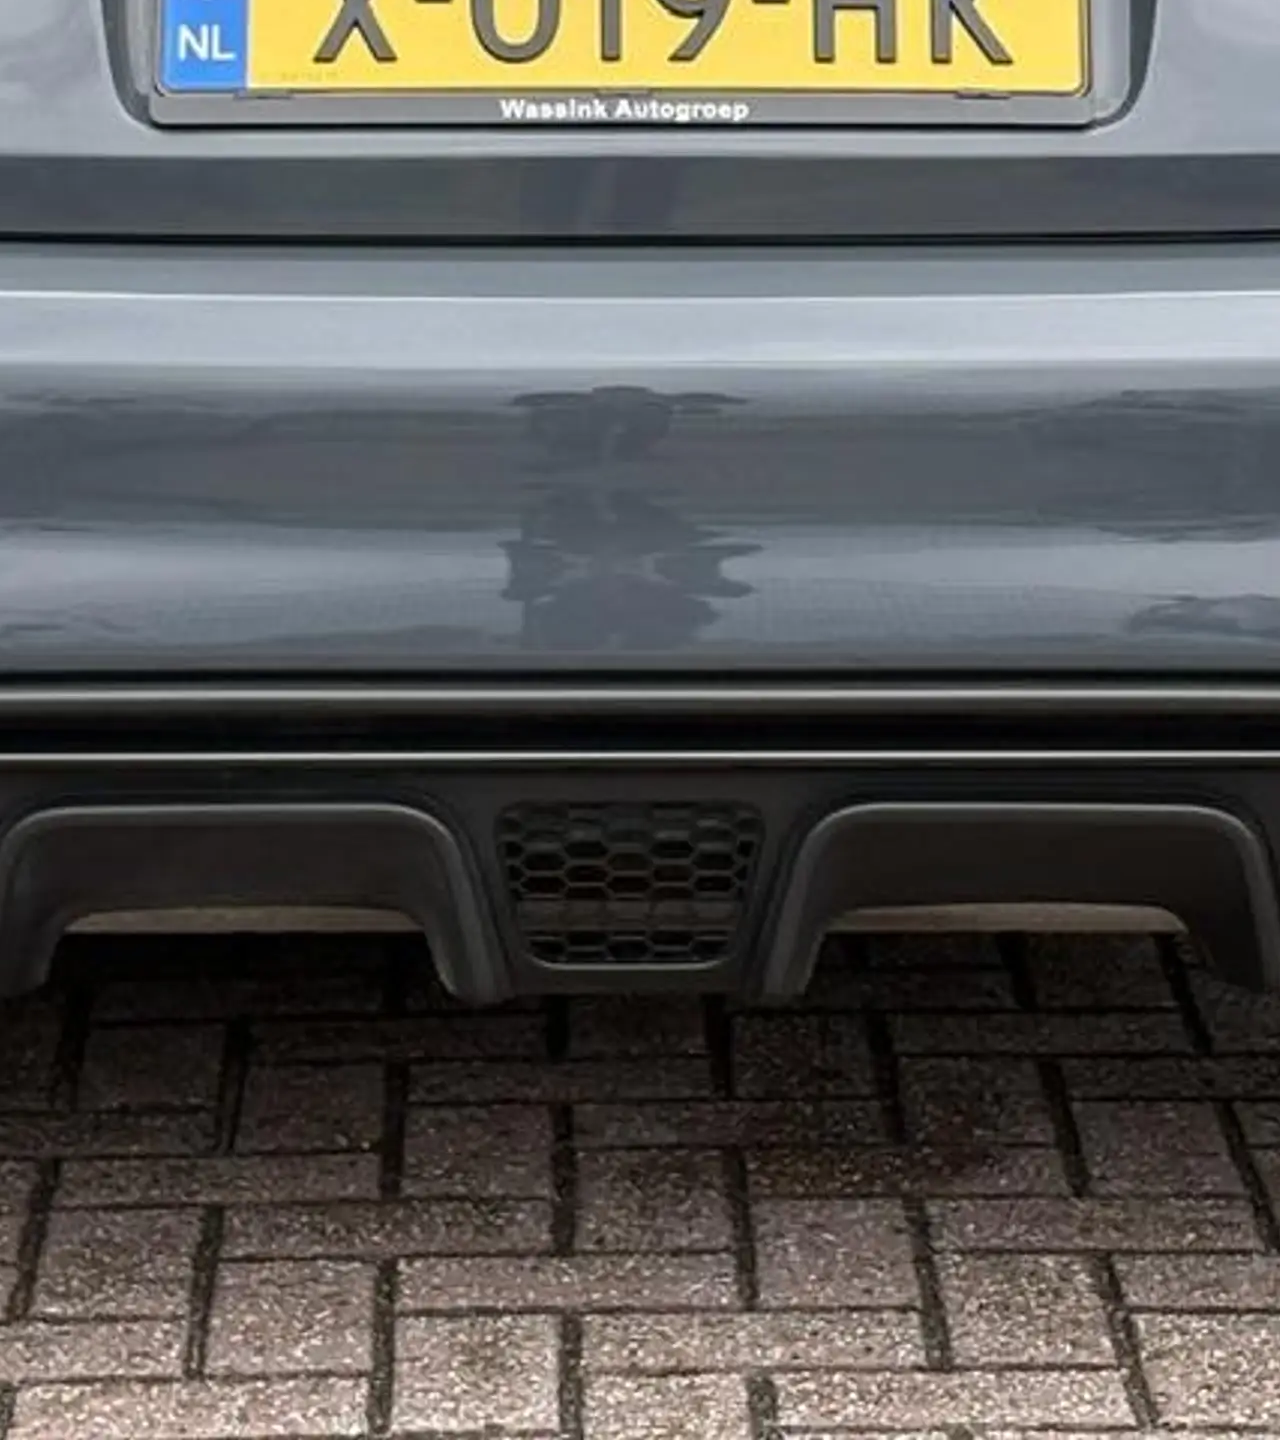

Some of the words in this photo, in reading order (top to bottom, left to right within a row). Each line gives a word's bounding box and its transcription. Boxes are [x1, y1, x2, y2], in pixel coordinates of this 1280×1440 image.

[178, 24, 237, 61] NL
[500, 99, 607, 119] Wassink
[615, 99, 749, 121] Autogroep
